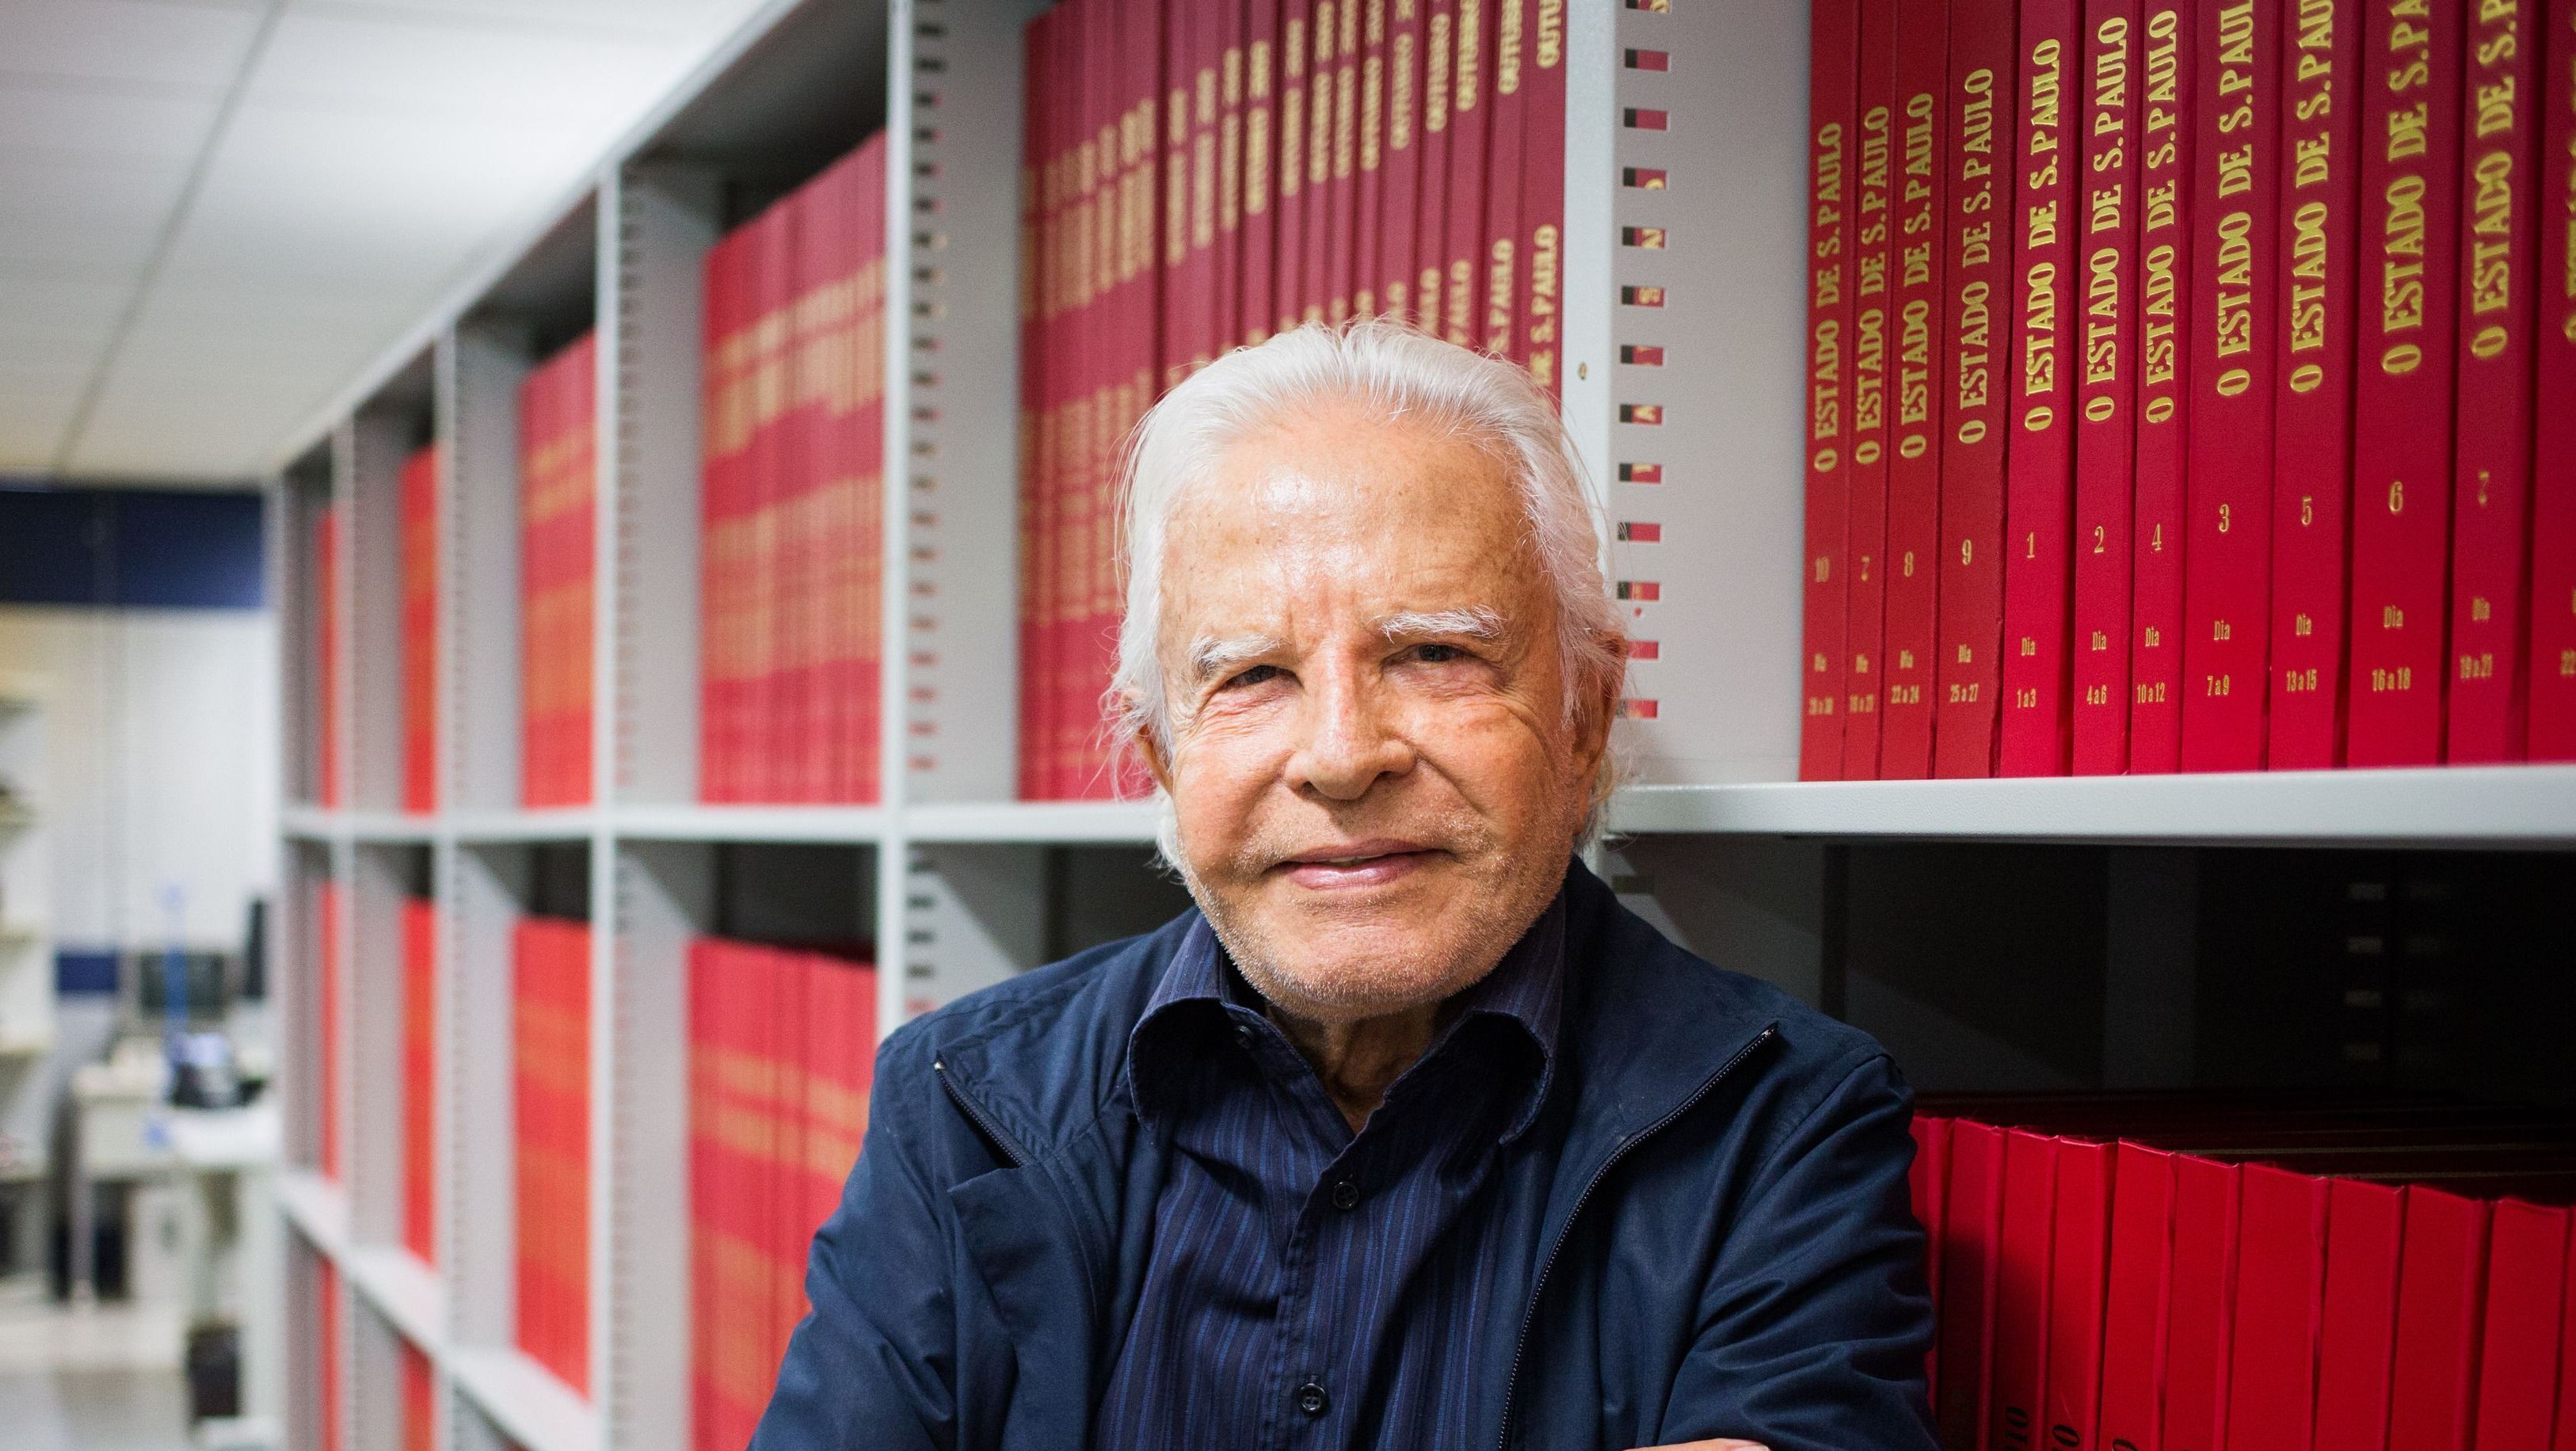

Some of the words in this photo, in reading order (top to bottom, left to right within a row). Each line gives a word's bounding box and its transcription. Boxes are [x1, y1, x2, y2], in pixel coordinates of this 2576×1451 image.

[2475, 75, 2516, 139] DE
[2387, 101, 2428, 162] DE
[2217, 143, 2253, 199] DE
[2293, 131, 2330, 189] DE
[2090, 183, 2122, 233] DE
[2146, 178, 2176, 231] DE
[2027, 199, 2057, 249] DE
[2471, 150, 2513, 314] ESTADO
[1961, 221, 1991, 267] DE
[2383, 174, 2425, 333] ESTADO
[1859, 252, 1886, 296] DE
[1903, 241, 1930, 287] DE
[2290, 200, 2328, 353] ESTADO
[1816, 265, 1841, 308] DE
[2216, 211, 2252, 358] ESTADO
[2025, 261, 2056, 396] ESTADO
[2086, 247, 2120, 385] ESTADO
[2145, 244, 2175, 386] ESTADO
[1959, 280, 1990, 409] ESTADO
[2470, 325, 2508, 359] O
[1855, 308, 1884, 432] ESTADO
[1900, 299, 1930, 425] ESTADO
[2382, 344, 2422, 375] O
[1814, 319, 1839, 439] ESTADO
[2216, 368, 2251, 397] O
[2289, 364, 2323, 394] O
[2024, 405, 2054, 432] O
[2084, 395, 2115, 422] O
[2144, 396, 2175, 424] O
[1900, 433, 1927, 459] O
[1957, 419, 1987, 444] O
[1813, 447, 1839, 473] O
[1855, 440, 1881, 465] O
[2301, 496, 2312, 525] 5
[2388, 481, 2403, 513] 6
[2219, 504, 2230, 532] 3
[1962, 539, 1972, 565] 9
[2027, 531, 2035, 558] 1
[2094, 526, 2104, 553] 2
[2151, 523, 2162, 550] 4
[1903, 551, 1914, 577] 8
[2213, 619, 2231, 640] Dia
[2296, 613, 2311, 635] Dia
[2384, 605, 2403, 628] Dia
[2022, 637, 2036, 656] Dia
[2092, 630, 2106, 650] Dia
[2145, 626, 2159, 646] Dia
